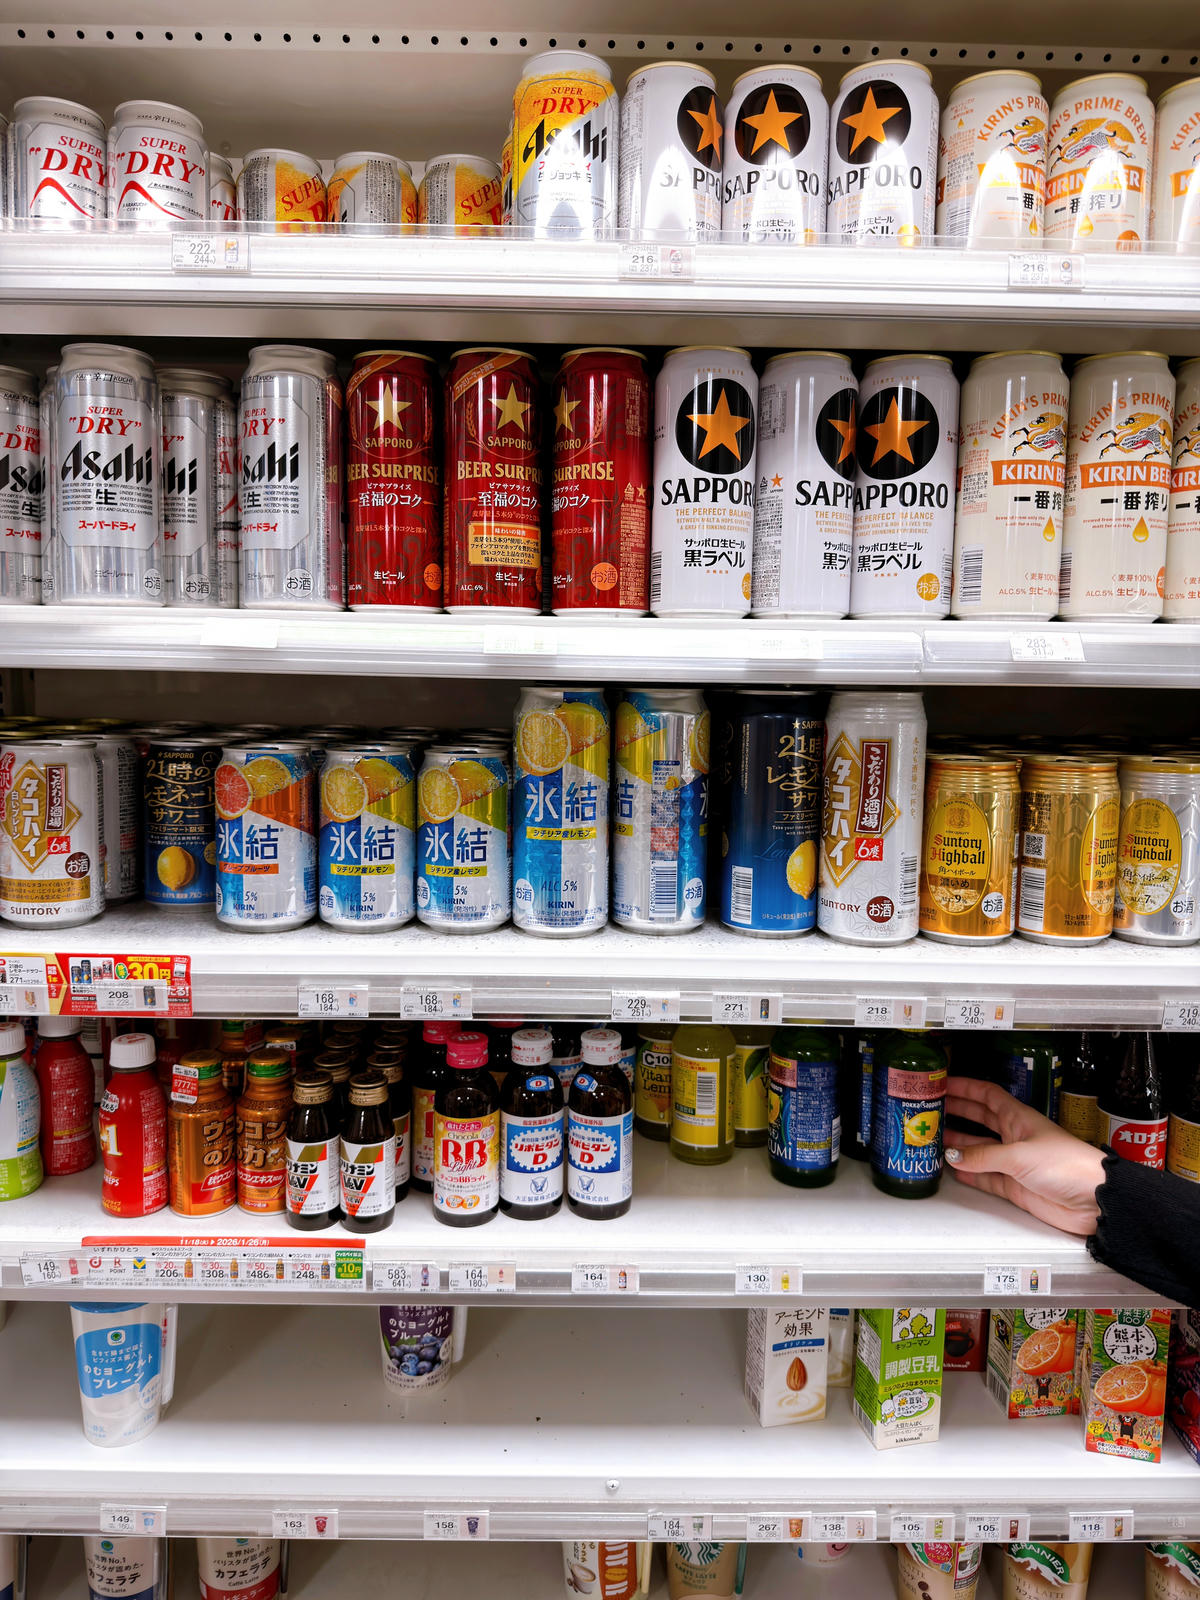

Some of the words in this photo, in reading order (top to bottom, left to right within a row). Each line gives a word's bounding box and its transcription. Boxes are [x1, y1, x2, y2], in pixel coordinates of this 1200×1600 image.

[551, 87, 583, 95] SUPER
[977, 96, 1024, 141] KIRIN'S
[1074, 96, 1123, 115] PRIME
[1123, 106, 1149, 146] BREW
[58, 135, 103, 160] SUPER
[139, 136, 187, 155] SUPER
[87, 405, 123, 416] SUPER
[991, 394, 1040, 440] KIRIN'S
[1080, 395, 1127, 443] KIRIN'S
[1132, 392, 1171, 411] PRIME
[365, 437, 413, 449] SAPPORO
[487, 436, 533, 450] SAPPORO
[61, 440, 152, 485] Asahi
[457, 461, 492, 479] BEER
[1001, 463, 1054, 481] KIRIN
[1089, 464, 1147, 483] KIRIN
[489, 482, 531, 492] ビアサプライズ
[95, 489, 118, 506] 生
[358, 491, 423, 508] 至福のコク
[478, 490, 538, 510] 至福のコク
[675, 508, 690, 516] THE
[692, 508, 727, 517] PERFECT
[78, 520, 136, 532] スーパードライ
[684, 537, 746, 550] サッポロ生ビール
[858, 542, 923, 553] サッポロ生ビール
[684, 550, 746, 569] 黒ラベル
[857, 552, 923, 572] 黒ラベル
[374, 571, 405, 581] 生ビール
[495, 572, 525, 582] 生ビール
[186, 580, 211, 594] お酒
[286, 575, 312, 591] お酒
[918, 579, 940, 595] お酒
[1116, 587, 1147, 598] 生ビール
[163, 751, 194, 760] SAPPORO
[146, 760, 211, 780] 21時の
[861, 744, 882, 830] こだわり酒場
[48, 768, 66, 828] こだわり酒場
[526, 780, 599, 824] 氷結
[21, 777, 42, 858] タコハイ
[831, 755, 853, 867] タコハイ
[532, 828, 592, 840] シチリア産レモン
[217, 823, 281, 862] 氷結
[329, 825, 397, 863] 氷結
[425, 826, 489, 864] 氷結
[934, 834, 982, 851] Suntory
[1126, 833, 1170, 850] Suntory
[930, 848, 986, 866] Highball
[1122, 846, 1173, 862] Highball
[66, 857, 90, 873] お酒
[222, 863, 272, 873] グレープフルーツ
[336, 865, 389, 876] シチリア産レモン
[938, 866, 976, 877] 角ハイボール
[430, 867, 481, 877] シチリア産レモン
[1123, 867, 1170, 884] 角ハイボール
[563, 880, 578, 893] 5%
[940, 879, 970, 889] 濃いめ
[244, 891, 258, 902] 5%
[362, 892, 376, 903] 5%
[454, 885, 468, 897] 5%
[684, 886, 703, 899] お酒
[10, 905, 61, 916] SUNTORY
[233, 903, 256, 911] KIRIN
[349, 904, 374, 913] KIRIN
[548, 901, 575, 909] KIRIN
[821, 897, 861, 913] SUNTORY
[868, 901, 892, 918] お酒
[983, 898, 1003, 912] お酒
[1172, 900, 1194, 913] お酒
[315, 994, 334, 1004] 168
[419, 994, 438, 1005] 168
[627, 999, 646, 1009] 229
[320, 1003, 333, 1012] 184
[424, 1004, 437, 1013] 184
[631, 1008, 645, 1017] 251
[724, 1003, 743, 1011] 271
[867, 1006, 887, 1014] 218
[961, 1005, 980, 1017] 219
[1179, 1007, 1199, 1019] 219
[964, 1016, 979, 1024] 240
[447, 1131, 480, 1140] Chocola
[514, 1139, 561, 1153] リポビタン
[569, 1139, 611, 1153] リポビタン
[1144, 1145, 1158, 1159] C
[441, 1139, 488, 1167] BB
[532, 1152, 548, 1166] D
[579, 1151, 595, 1165] D
[904, 1148, 937, 1159] キレートレモン
[449, 1159, 479, 1175] Light
[37, 1261, 56, 1273] 149
[209, 1262, 220, 1270] 30
[163, 1269, 179, 1279] 206
[206, 1270, 224, 1279] 308
[251, 1270, 270, 1279] 486
[296, 1271, 315, 1280] 248
[387, 1269, 406, 1280] 583
[464, 1269, 482, 1280] 164
[584, 1272, 603, 1281] 164
[392, 1279, 405, 1288] 641
[469, 1279, 482, 1288] 180
[388, 1312, 450, 1330] のむヨーグルト
[775, 1307, 826, 1325] アーモンド
[390, 1324, 449, 1340] ブルーベリー
[784, 1322, 813, 1338] 効果
[1114, 1329, 1146, 1343] 熊本
[1107, 1344, 1157, 1357] デコポン
[84, 1353, 153, 1376] のむヨーグルト
[885, 1355, 941, 1380] 調製豆乳
[93, 1372, 145, 1389] プレーン
[112, 1515, 130, 1523] 149
[663, 1520, 680, 1530] 184
[244, 1544, 261, 1555] No.1
[215, 1557, 273, 1580] カフェラテ
[88, 1571, 141, 1586] カフェラテ
